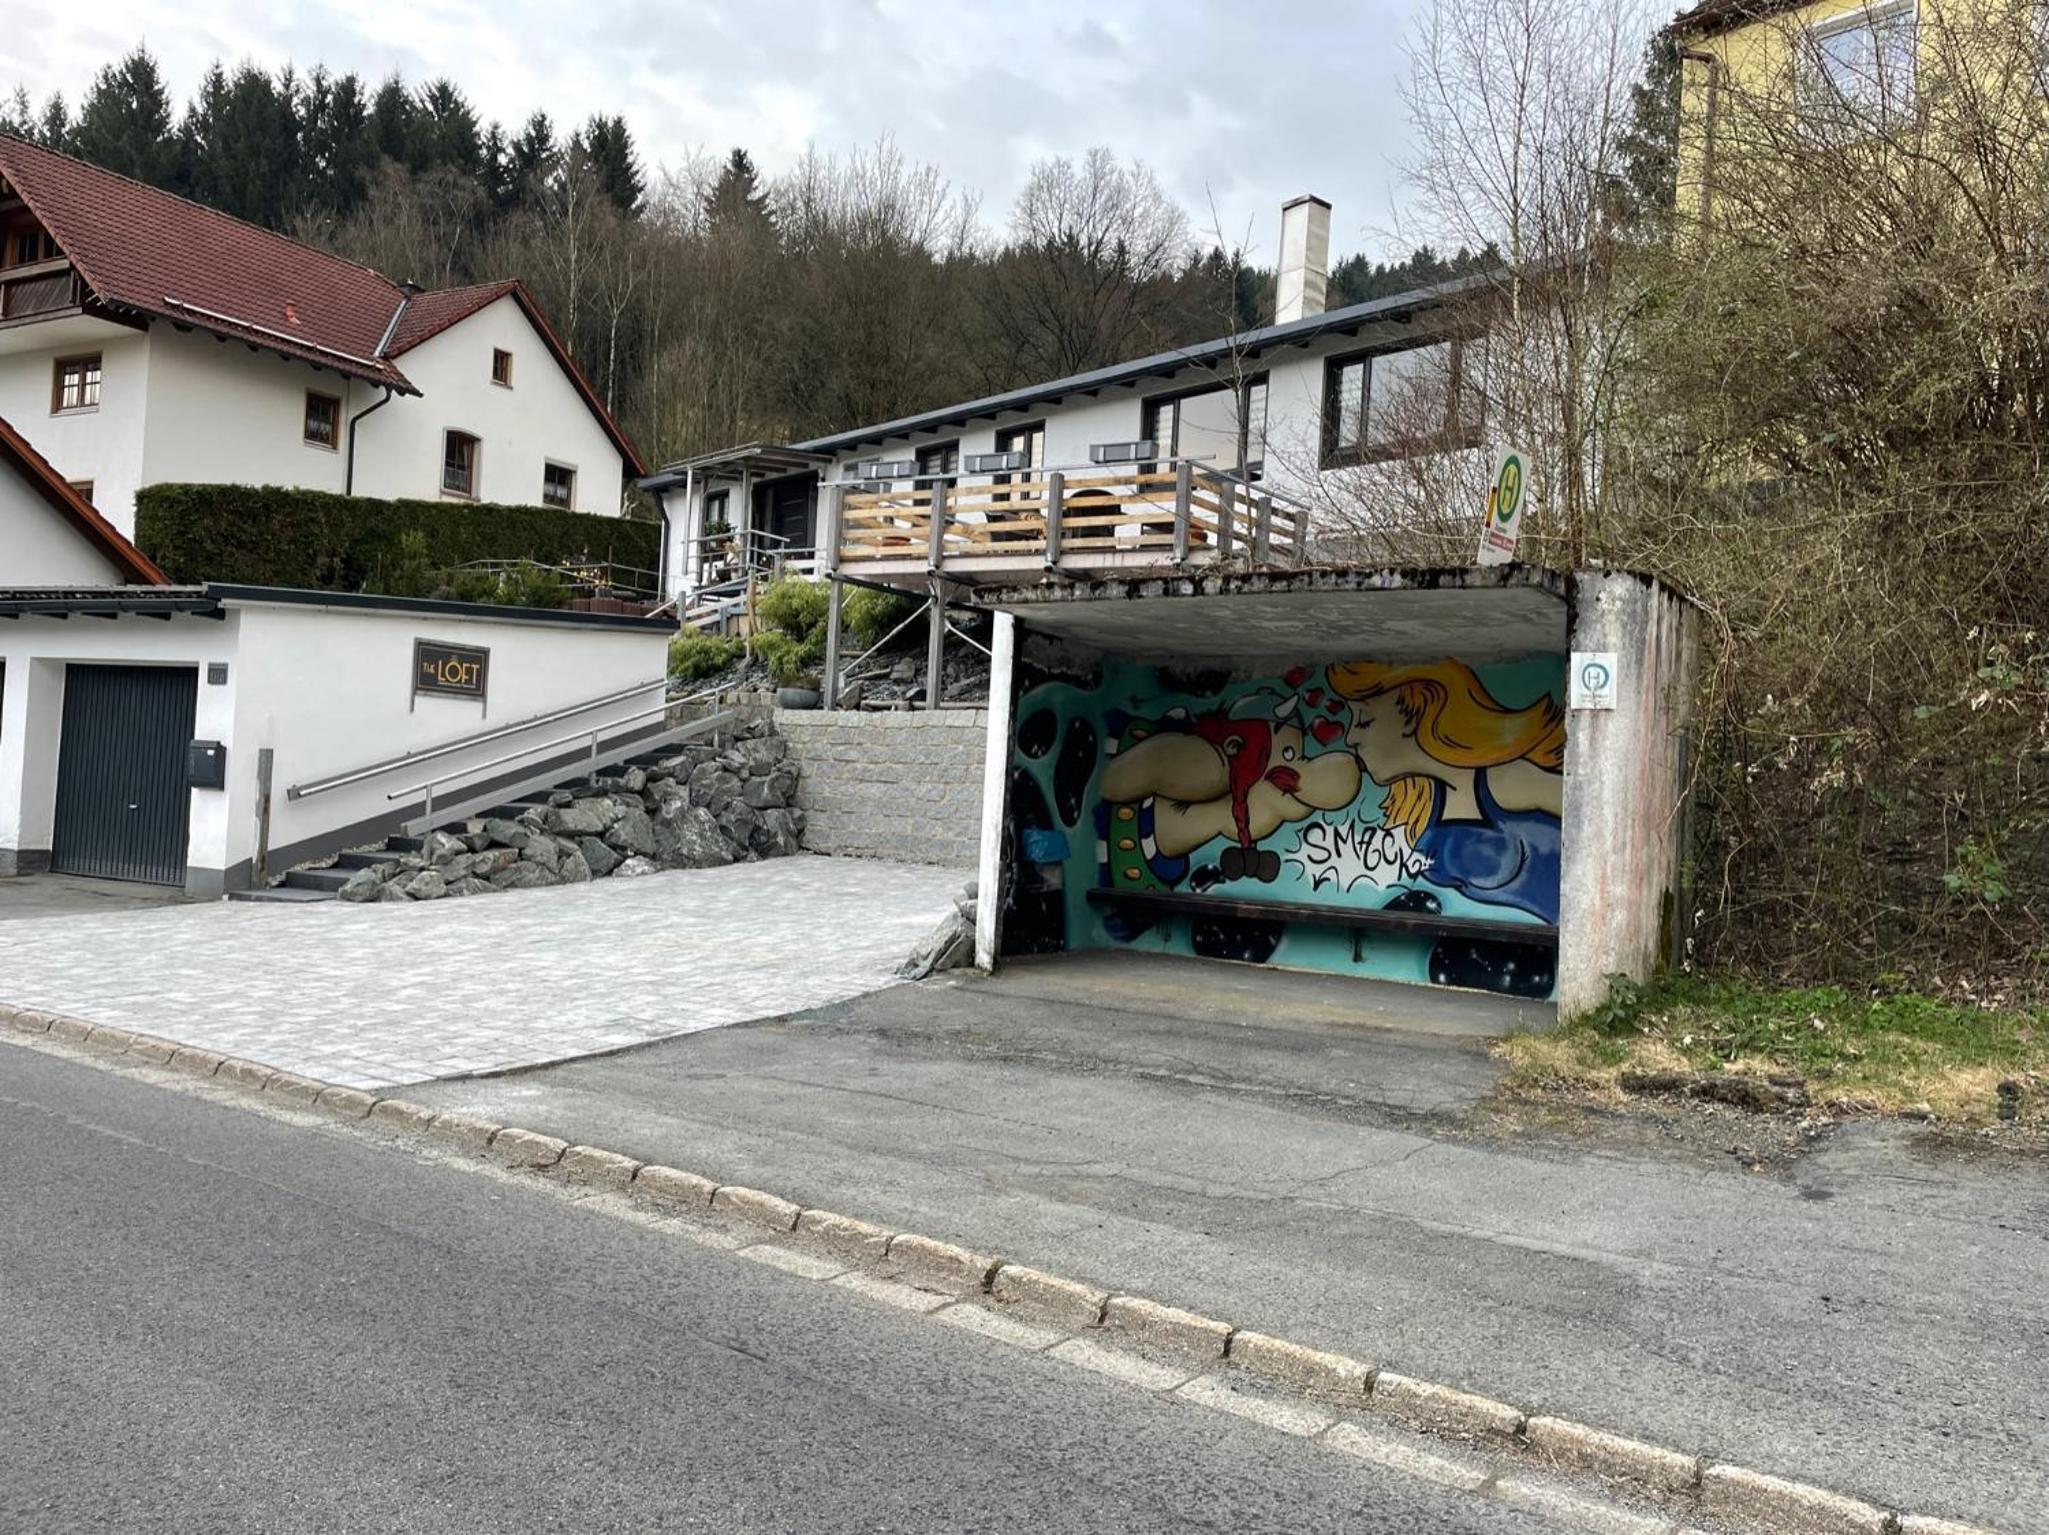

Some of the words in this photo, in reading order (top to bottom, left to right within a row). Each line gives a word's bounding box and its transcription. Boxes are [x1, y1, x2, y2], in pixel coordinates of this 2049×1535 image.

[1501, 469, 1517, 510] H
[437, 659, 480, 685] LOFT
[1587, 671, 1600, 686] H
[1302, 818, 1423, 881] SMACK
